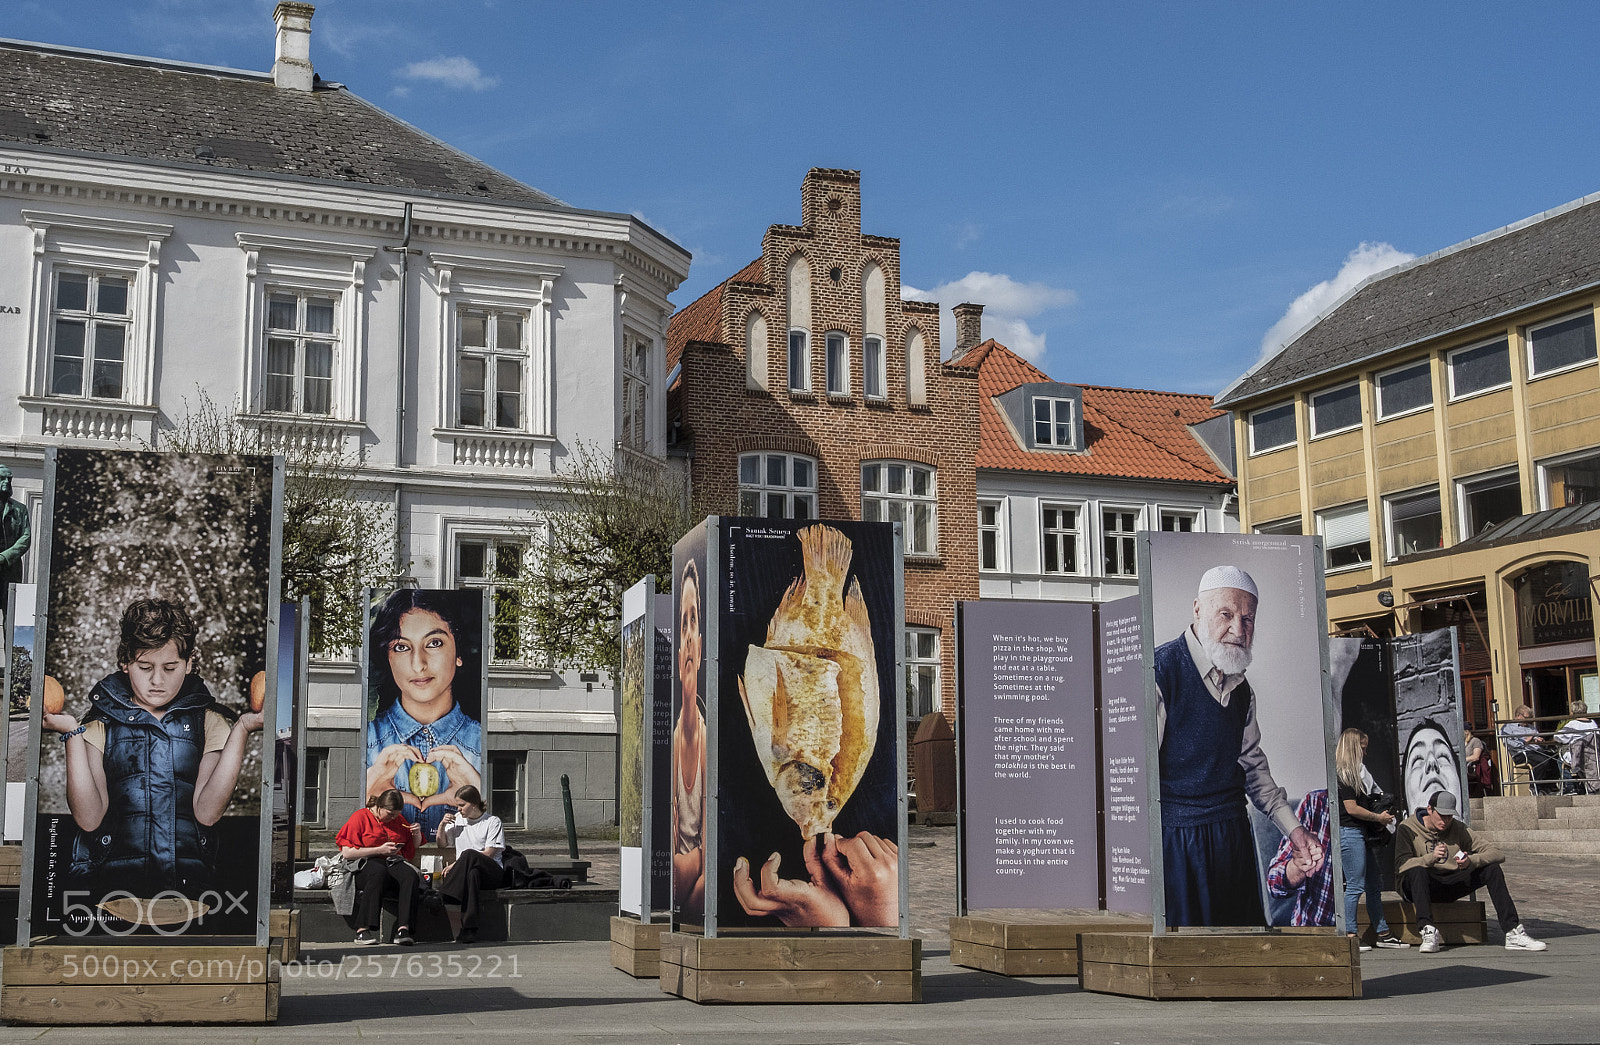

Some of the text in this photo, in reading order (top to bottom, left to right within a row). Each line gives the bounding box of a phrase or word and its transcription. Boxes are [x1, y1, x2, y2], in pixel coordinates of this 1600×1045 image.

[4, 164, 30, 174] HAV
[1056, 636, 1068, 644] buy
[994, 694, 1029, 702] swimming
[49, 818, 59, 850] Raghad,
[46, 872, 56, 898] Syrien
